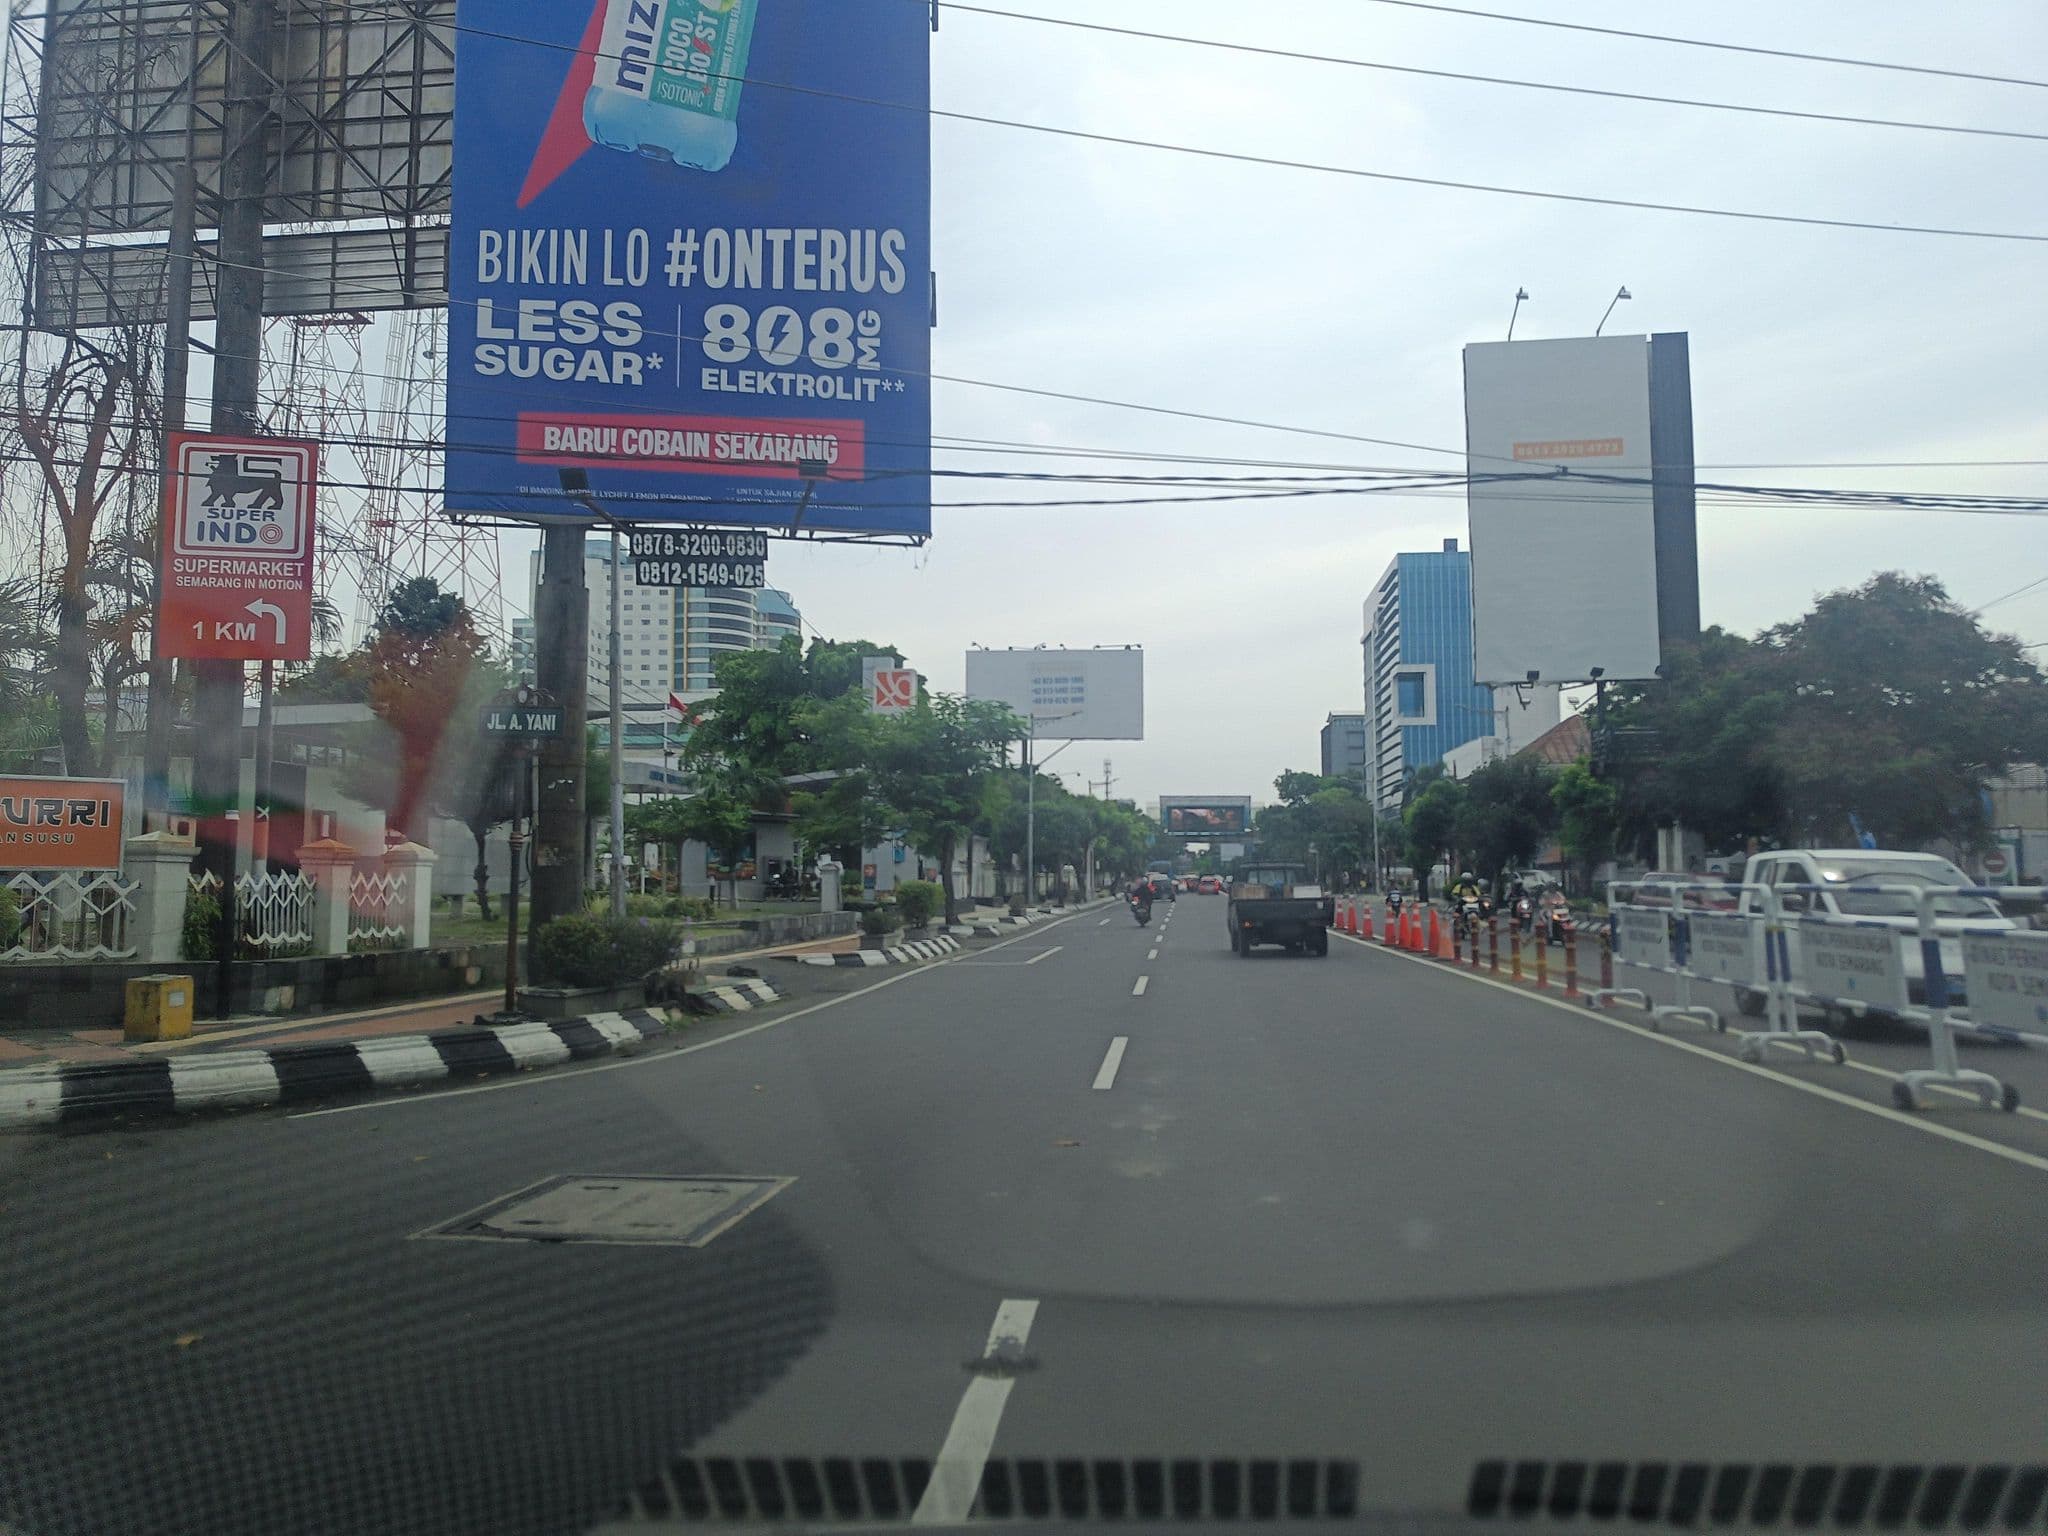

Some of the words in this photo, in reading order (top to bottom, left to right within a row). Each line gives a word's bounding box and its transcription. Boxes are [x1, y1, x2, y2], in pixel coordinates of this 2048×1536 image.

[662, 17, 694, 76] COCO
[657, 81, 705, 107] ISOTONIC
[478, 228, 588, 285] BIKIN
[603, 228, 650, 287] LO
[664, 227, 906, 294] #ONTERUS
[476, 298, 644, 347] LESS
[702, 303, 855, 369] 808
[857, 310, 881, 371] MG
[544, 426, 617, 453] BARU!
[622, 428, 710, 458] COBAIN
[714, 431, 838, 464] SEKARANG
[207, 508, 275, 521] SUPER
[197, 521, 283, 545] INDO
[633, 533, 765, 557] 0878-3200-0830
[173, 558, 305, 577] SUPERMARKET
[640, 561, 764, 586] 0812-1549-025
[176, 576, 241, 589] SEMARANG
[244, 578, 255, 589] IN
[258, 579, 303, 590] MOTION
[192, 621, 203, 640] 1
[215, 621, 256, 641] KM
[487, 713, 506, 730] JL.
[509, 713, 522, 731] A.
[525, 713, 556, 731] YANI
[24, 832, 75, 845] SUSU
